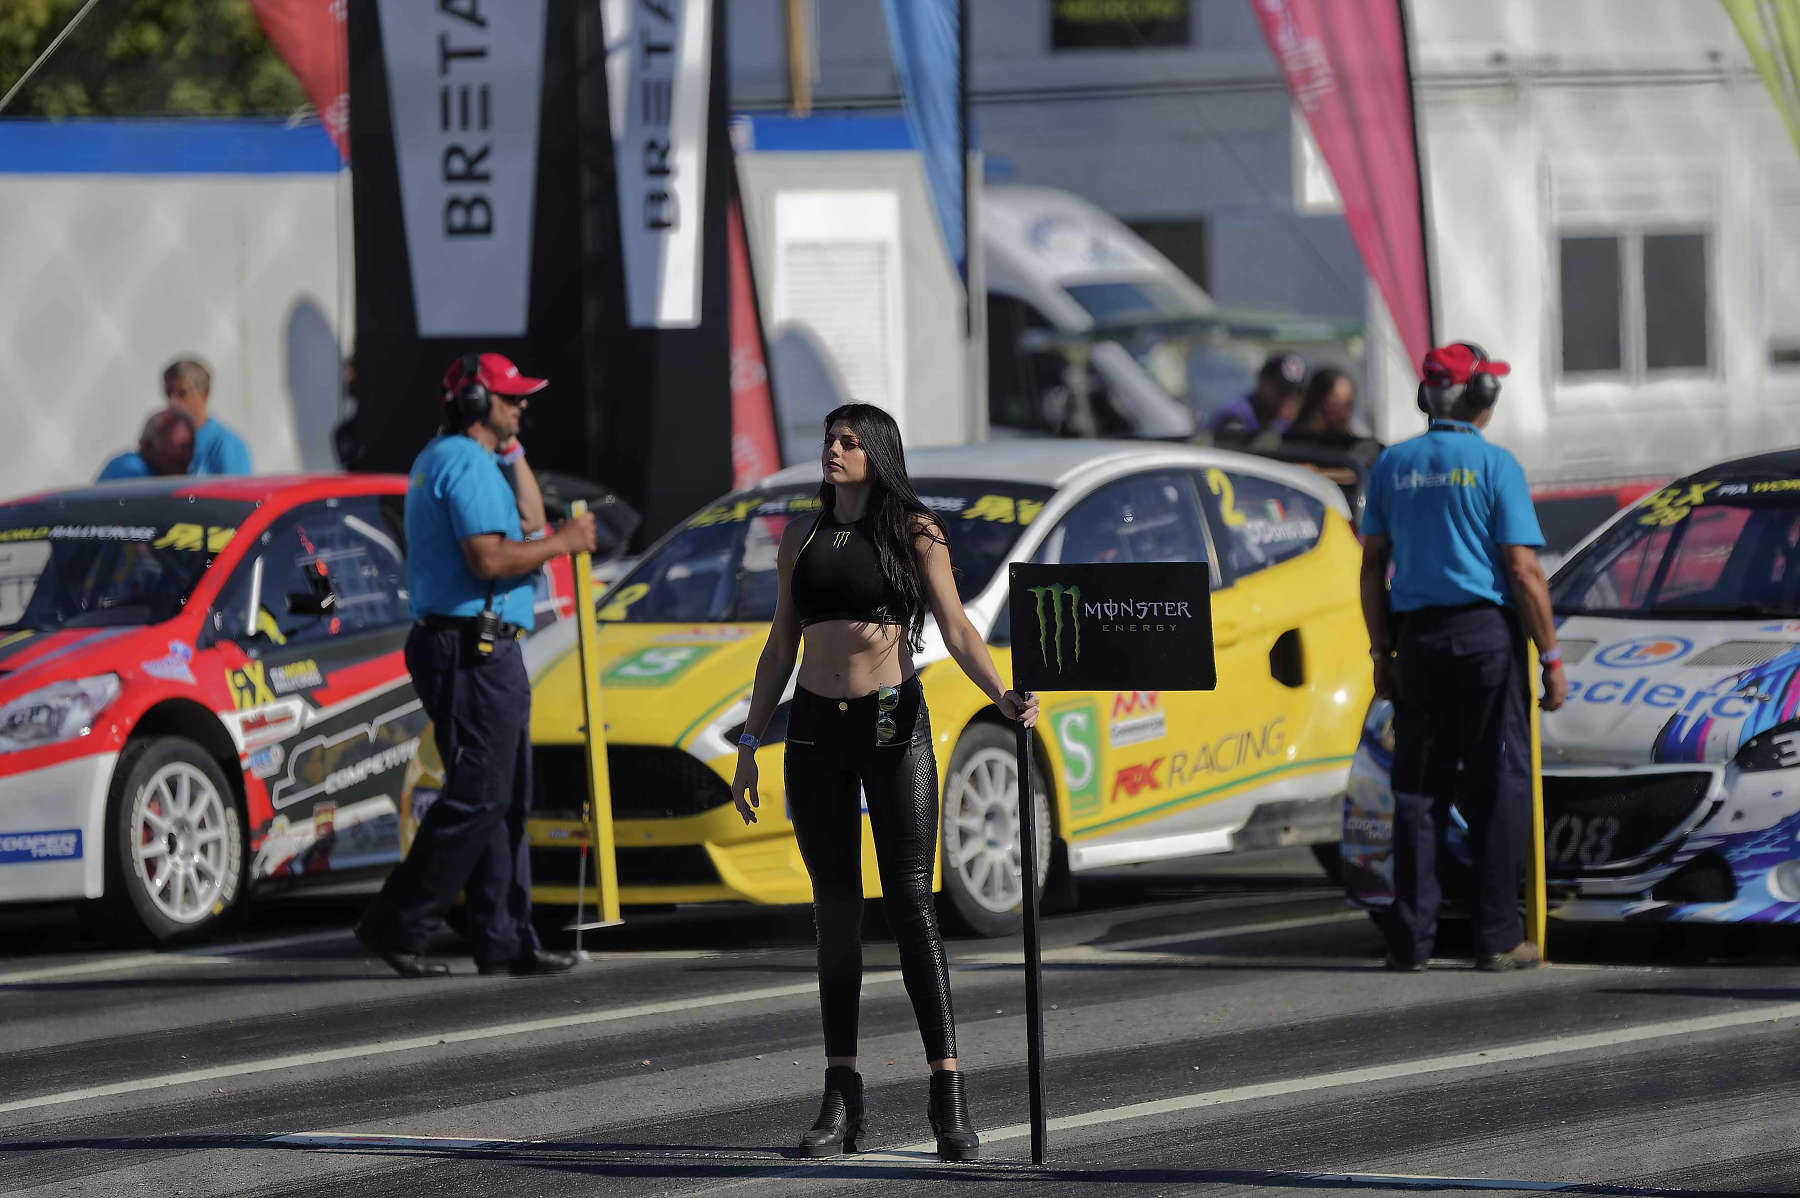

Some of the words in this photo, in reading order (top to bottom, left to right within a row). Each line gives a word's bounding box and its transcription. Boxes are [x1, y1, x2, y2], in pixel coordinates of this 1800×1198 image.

[1206, 466, 1245, 527] 2
[1084, 599, 1192, 621] MONSTER
[1101, 623, 1178, 633] ENERGY
[1059, 711, 1094, 791] S
[1167, 716, 1286, 789] RACING
[0, 832, 77, 853] OOPER
[1545, 814, 1620, 866] 08
